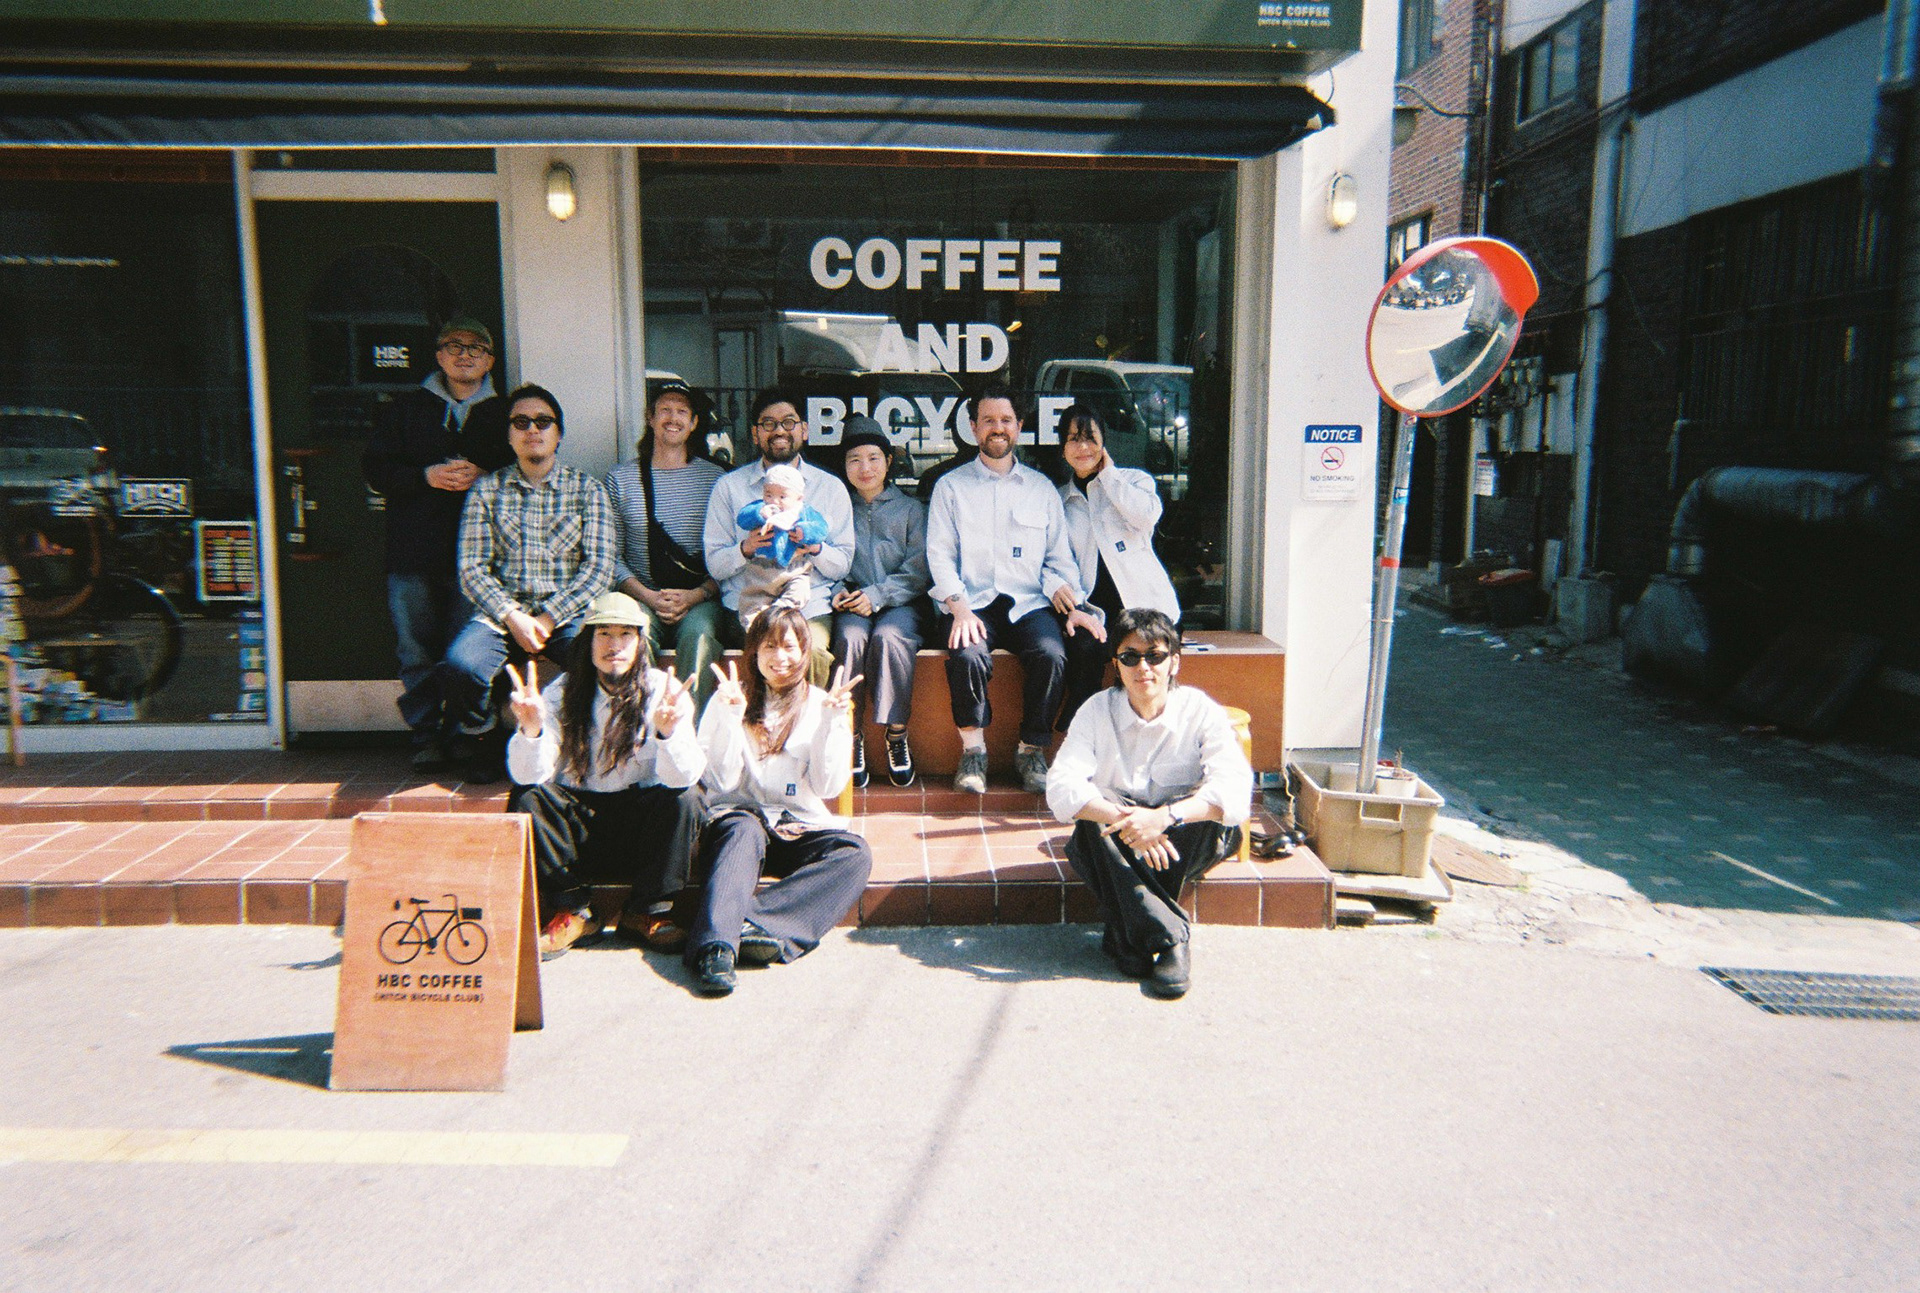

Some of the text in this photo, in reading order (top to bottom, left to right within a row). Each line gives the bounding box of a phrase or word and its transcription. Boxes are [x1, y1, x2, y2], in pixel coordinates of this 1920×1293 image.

[810, 237, 1061, 291] COFFEE
[374, 346, 410, 359] HBC
[870, 323, 1009, 373] AND
[1310, 429, 1357, 441] NOTICE
[377, 974, 483, 989] HBC COFFEE
